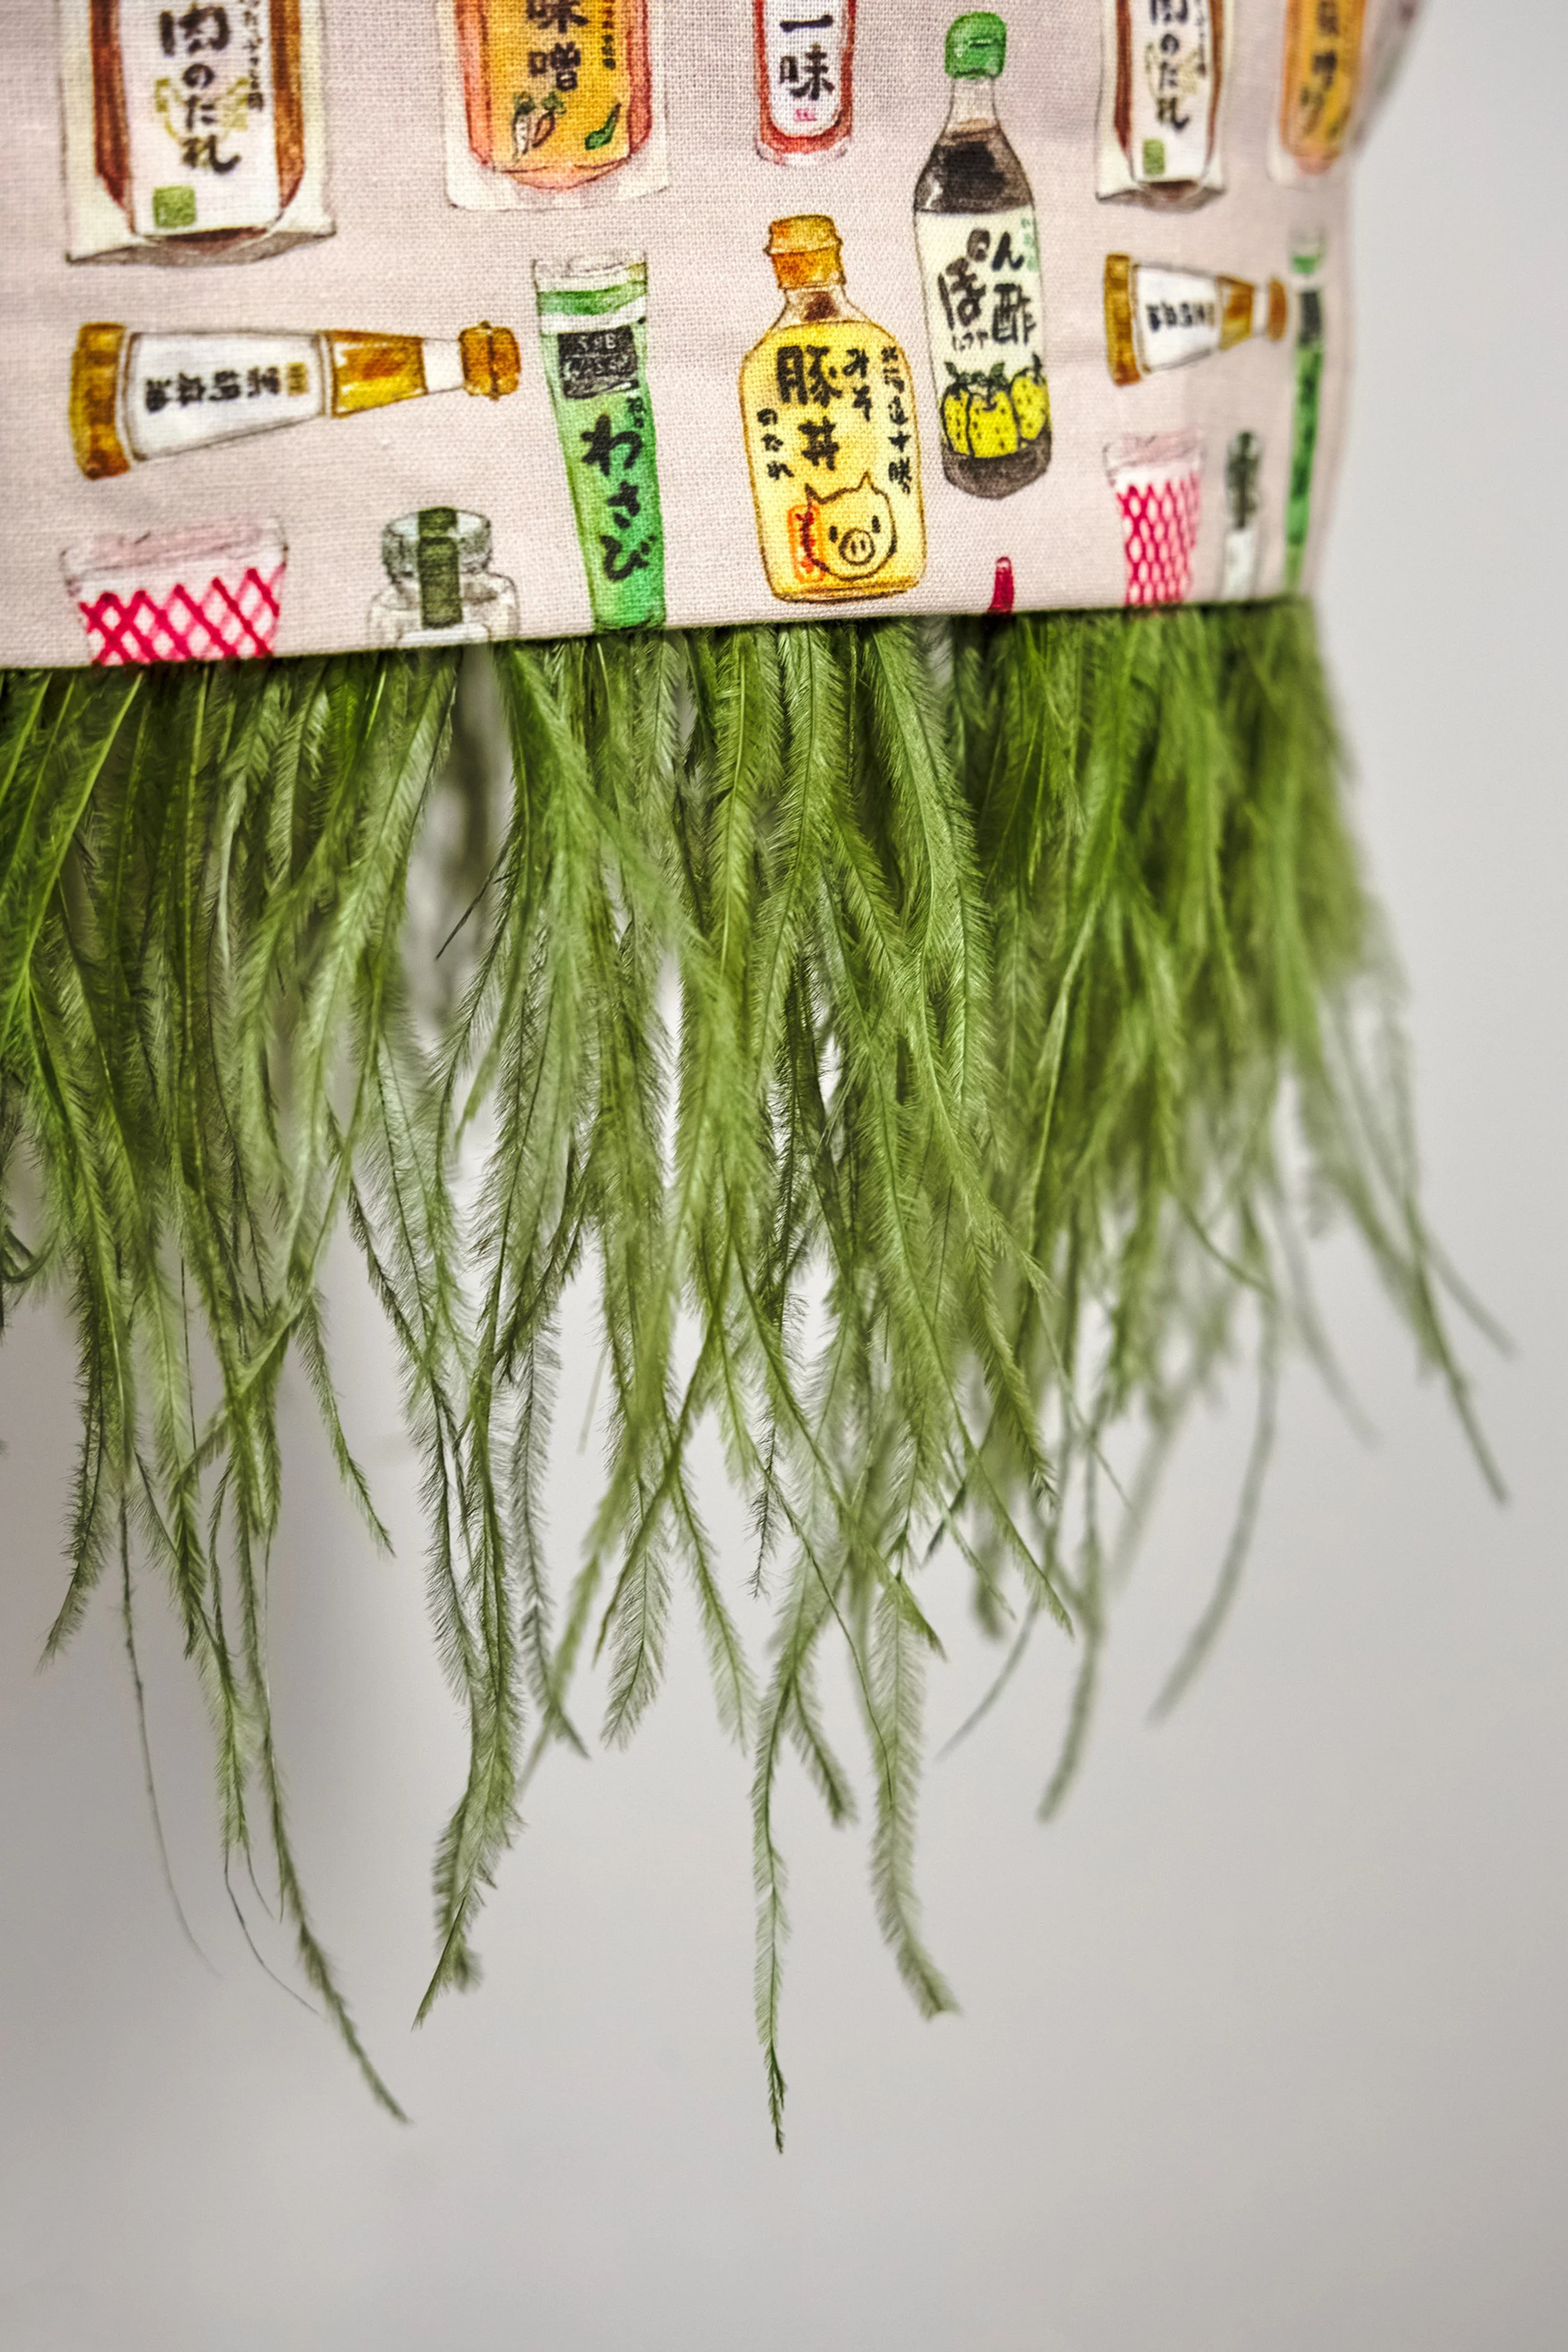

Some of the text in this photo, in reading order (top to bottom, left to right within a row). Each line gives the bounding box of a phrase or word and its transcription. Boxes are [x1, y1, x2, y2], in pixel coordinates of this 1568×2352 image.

[779, 13, 835, 101] 一味
[843, 348, 872, 422] みそ
[581, 413, 657, 582] わさび
